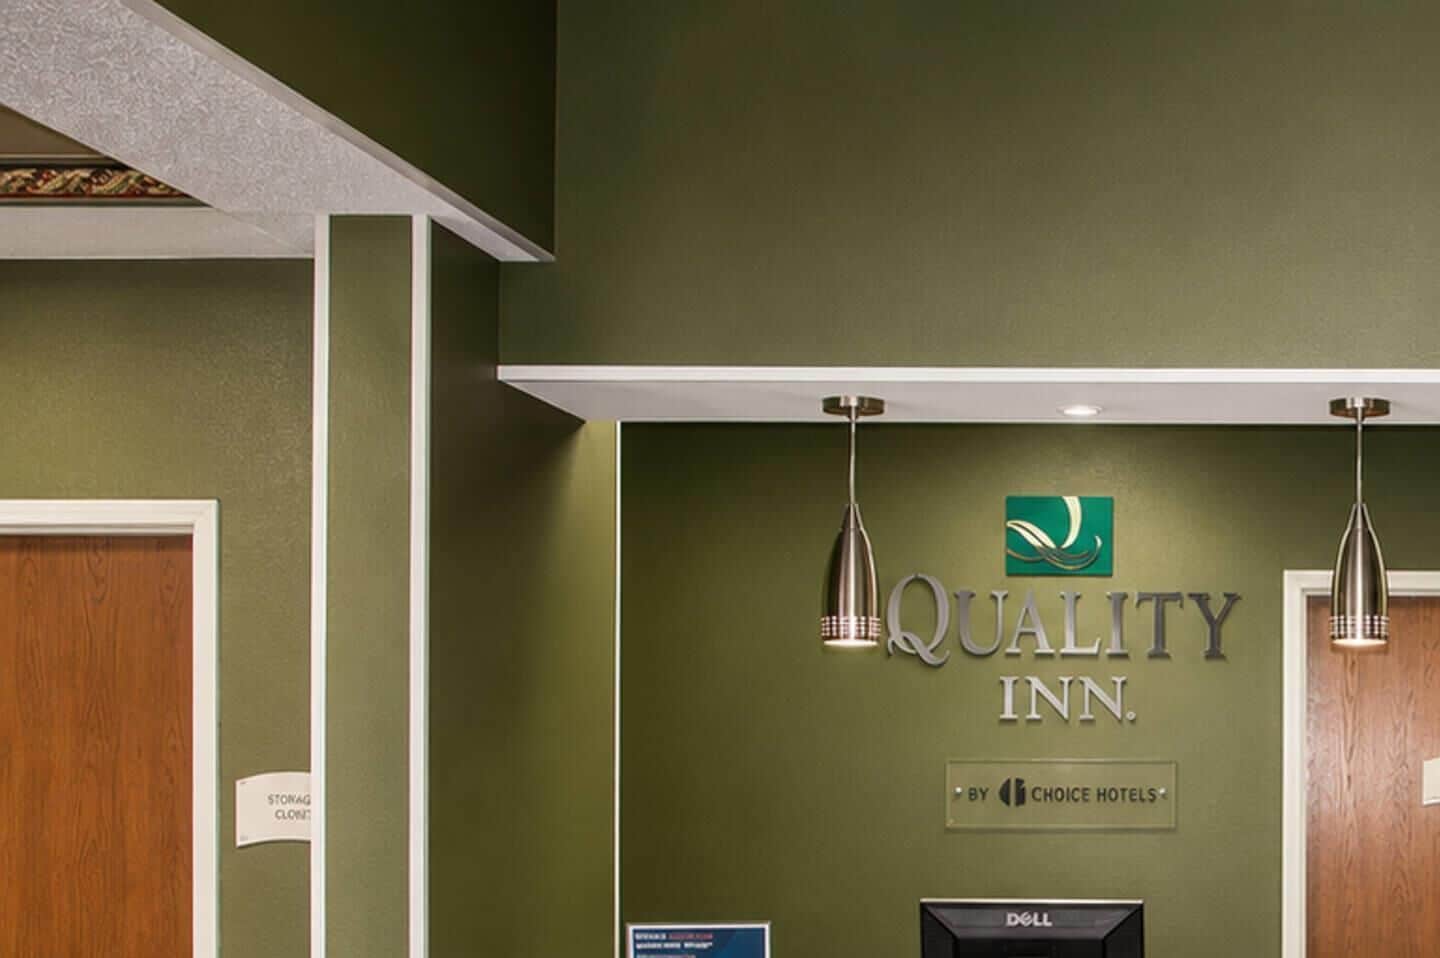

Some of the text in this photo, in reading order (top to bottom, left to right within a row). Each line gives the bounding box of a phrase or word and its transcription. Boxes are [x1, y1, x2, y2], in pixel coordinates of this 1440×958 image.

[886, 572, 1242, 667] QUALITY
[267, 793, 311, 806] STORAG
[967, 786, 1157, 803] BY CHOICE HOTELS
[1006, 911, 1053, 928] DELL
